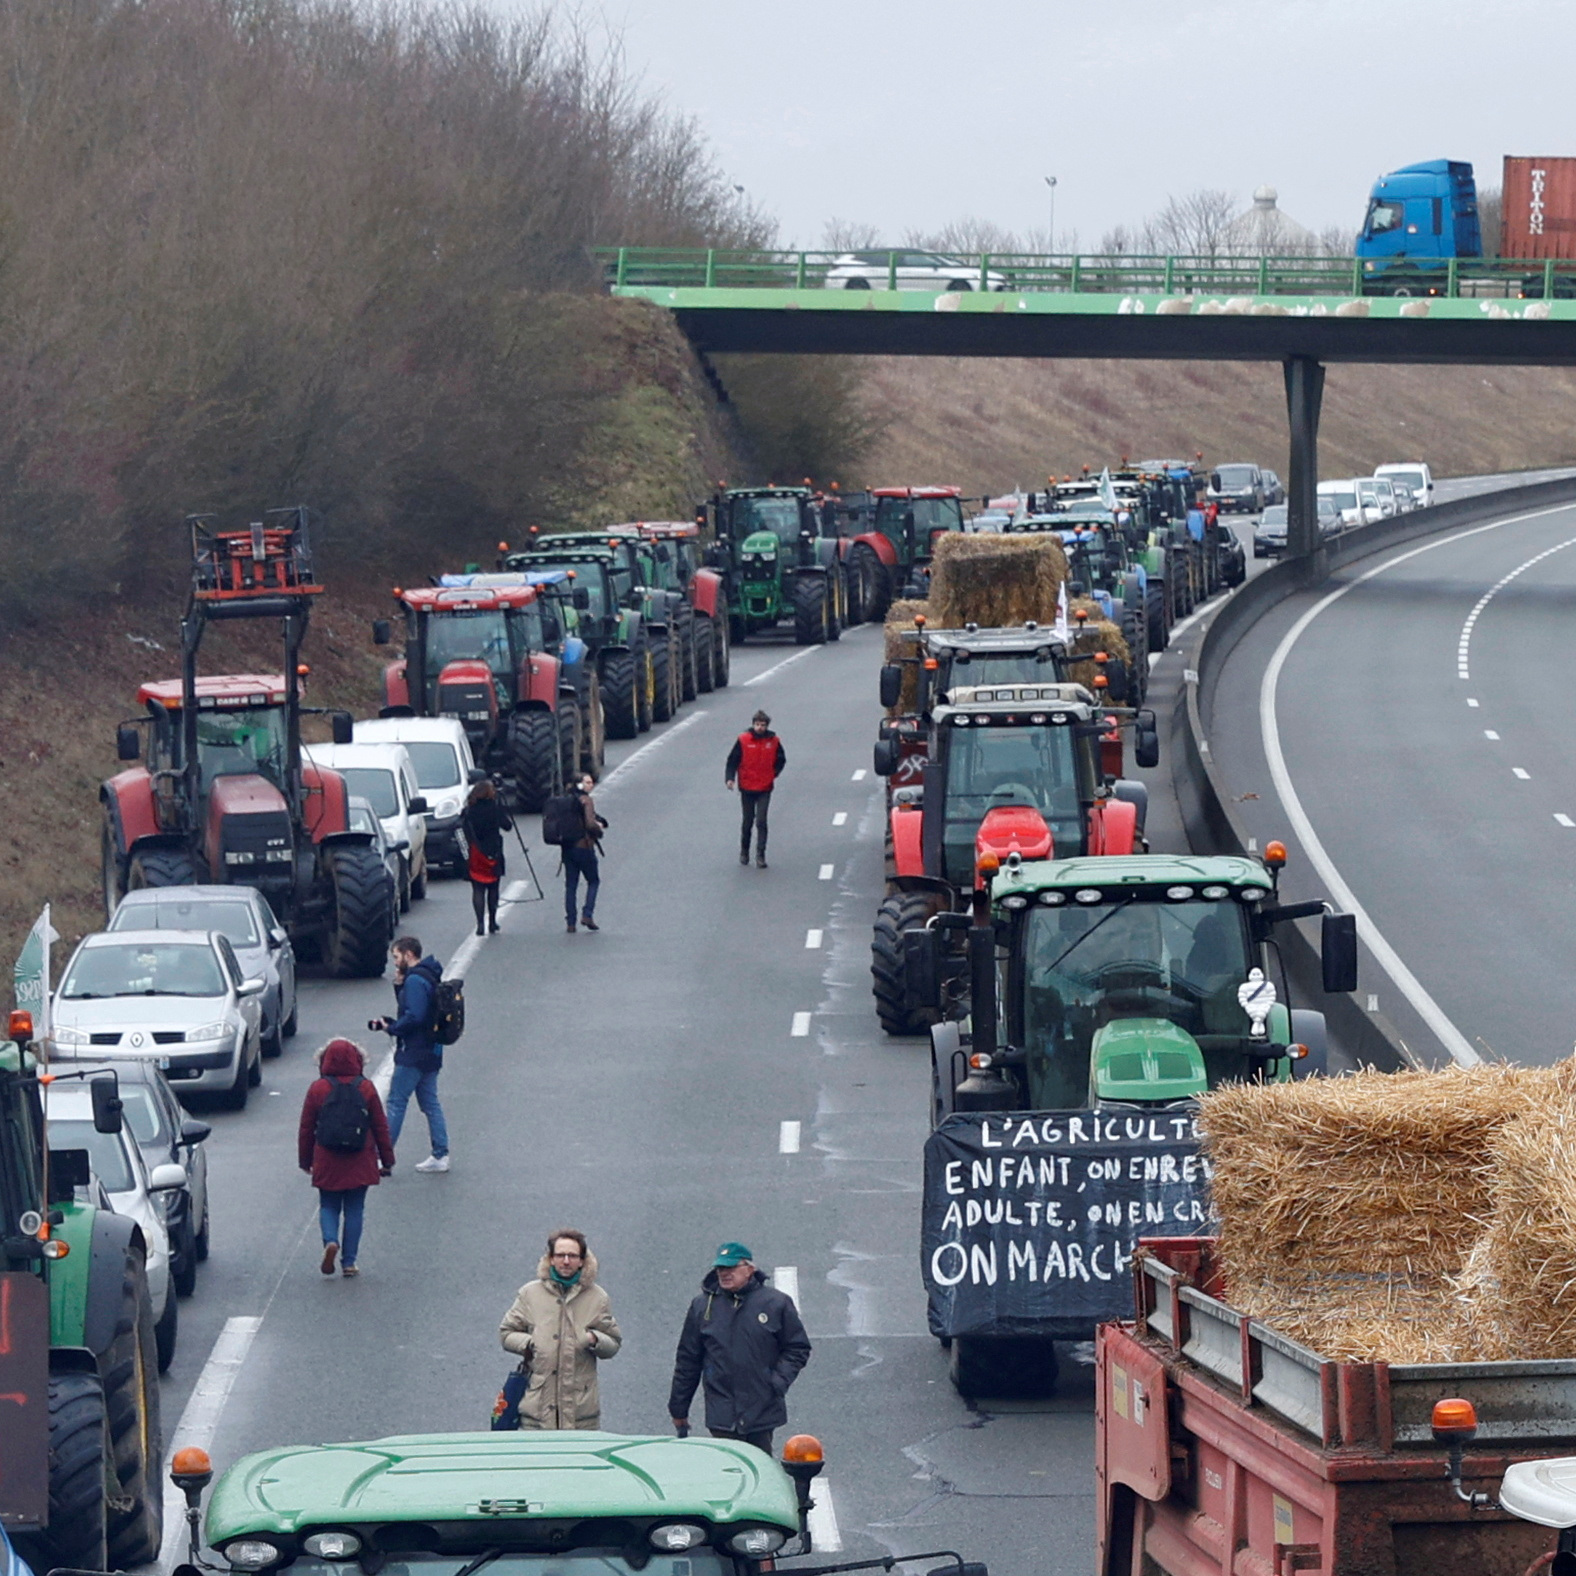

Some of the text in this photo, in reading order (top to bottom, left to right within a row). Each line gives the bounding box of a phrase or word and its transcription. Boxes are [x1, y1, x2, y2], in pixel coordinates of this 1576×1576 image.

[1529, 169, 1546, 235] TRITON
[1087, 1158, 1121, 1181] ON
[941, 1200, 1077, 1232] ADULTE,
[1087, 1200, 1122, 1227] ON
[1128, 1201, 1165, 1225] EN
[931, 1239, 998, 1287] ON
